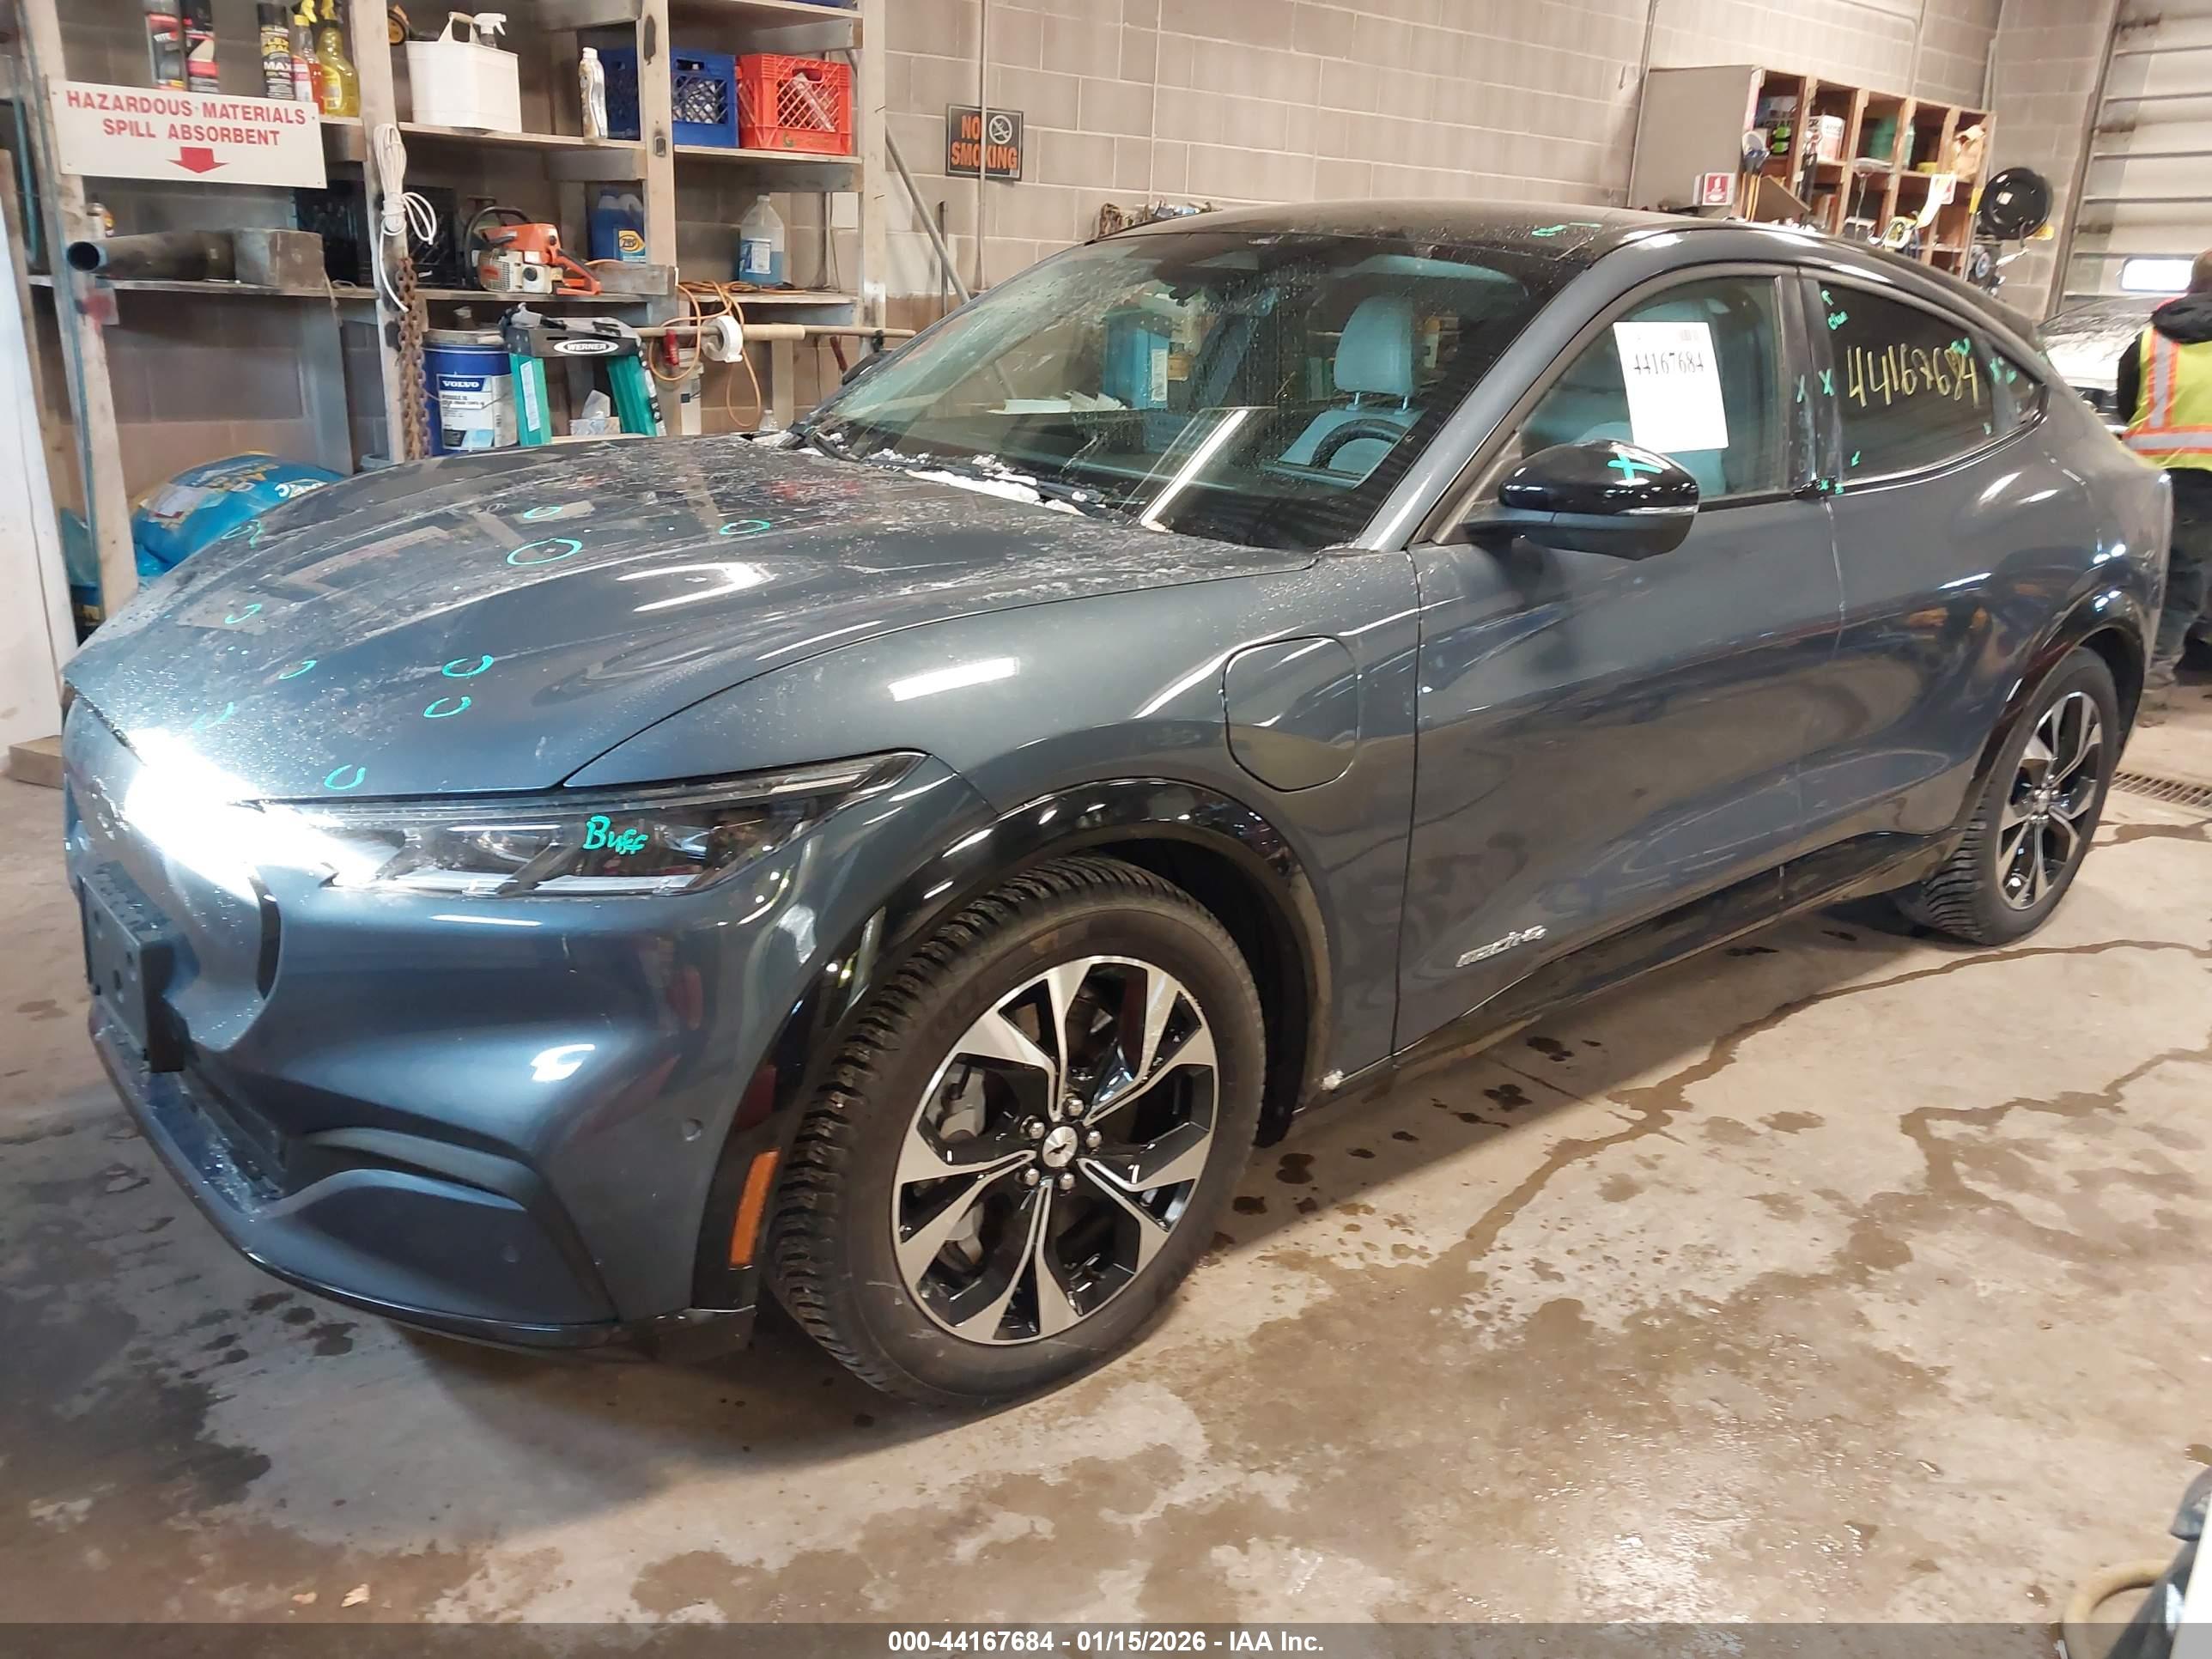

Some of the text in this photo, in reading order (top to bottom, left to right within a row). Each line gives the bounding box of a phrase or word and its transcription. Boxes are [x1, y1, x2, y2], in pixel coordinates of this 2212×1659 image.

[66, 90, 306, 125] HAZARDOUS MATERIALS
[103, 118, 280, 146] SPILL ABSORBENT
[962, 115, 981, 140] NO
[951, 141, 1018, 169] SMOKING
[441, 380, 480, 389] VOLVO
[1847, 343, 1978, 409] 44167684
